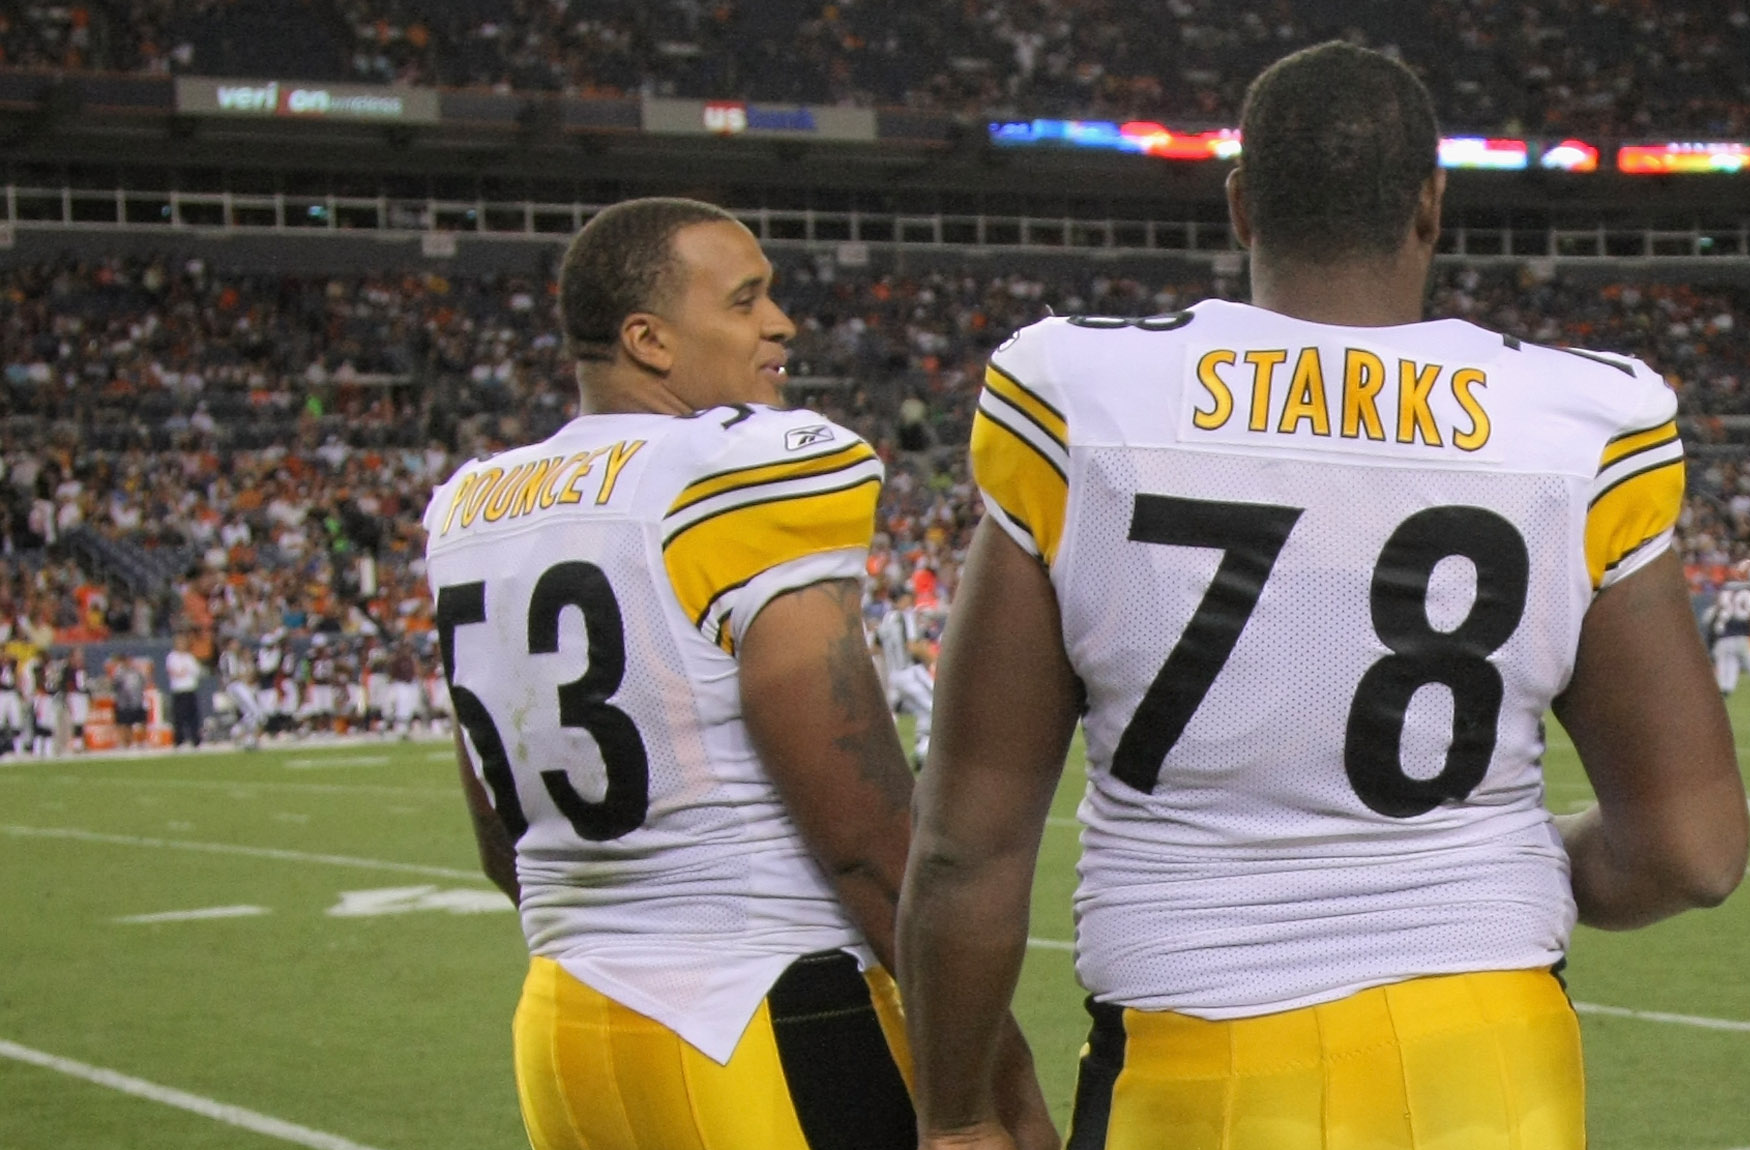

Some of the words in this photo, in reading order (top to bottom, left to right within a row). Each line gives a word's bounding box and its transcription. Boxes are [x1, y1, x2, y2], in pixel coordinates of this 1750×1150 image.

[440, 440, 648, 538] POUNCEY
[1193, 346, 1493, 452] STARKS
[437, 560, 649, 841] 53
[1110, 492, 1530, 819] 78
